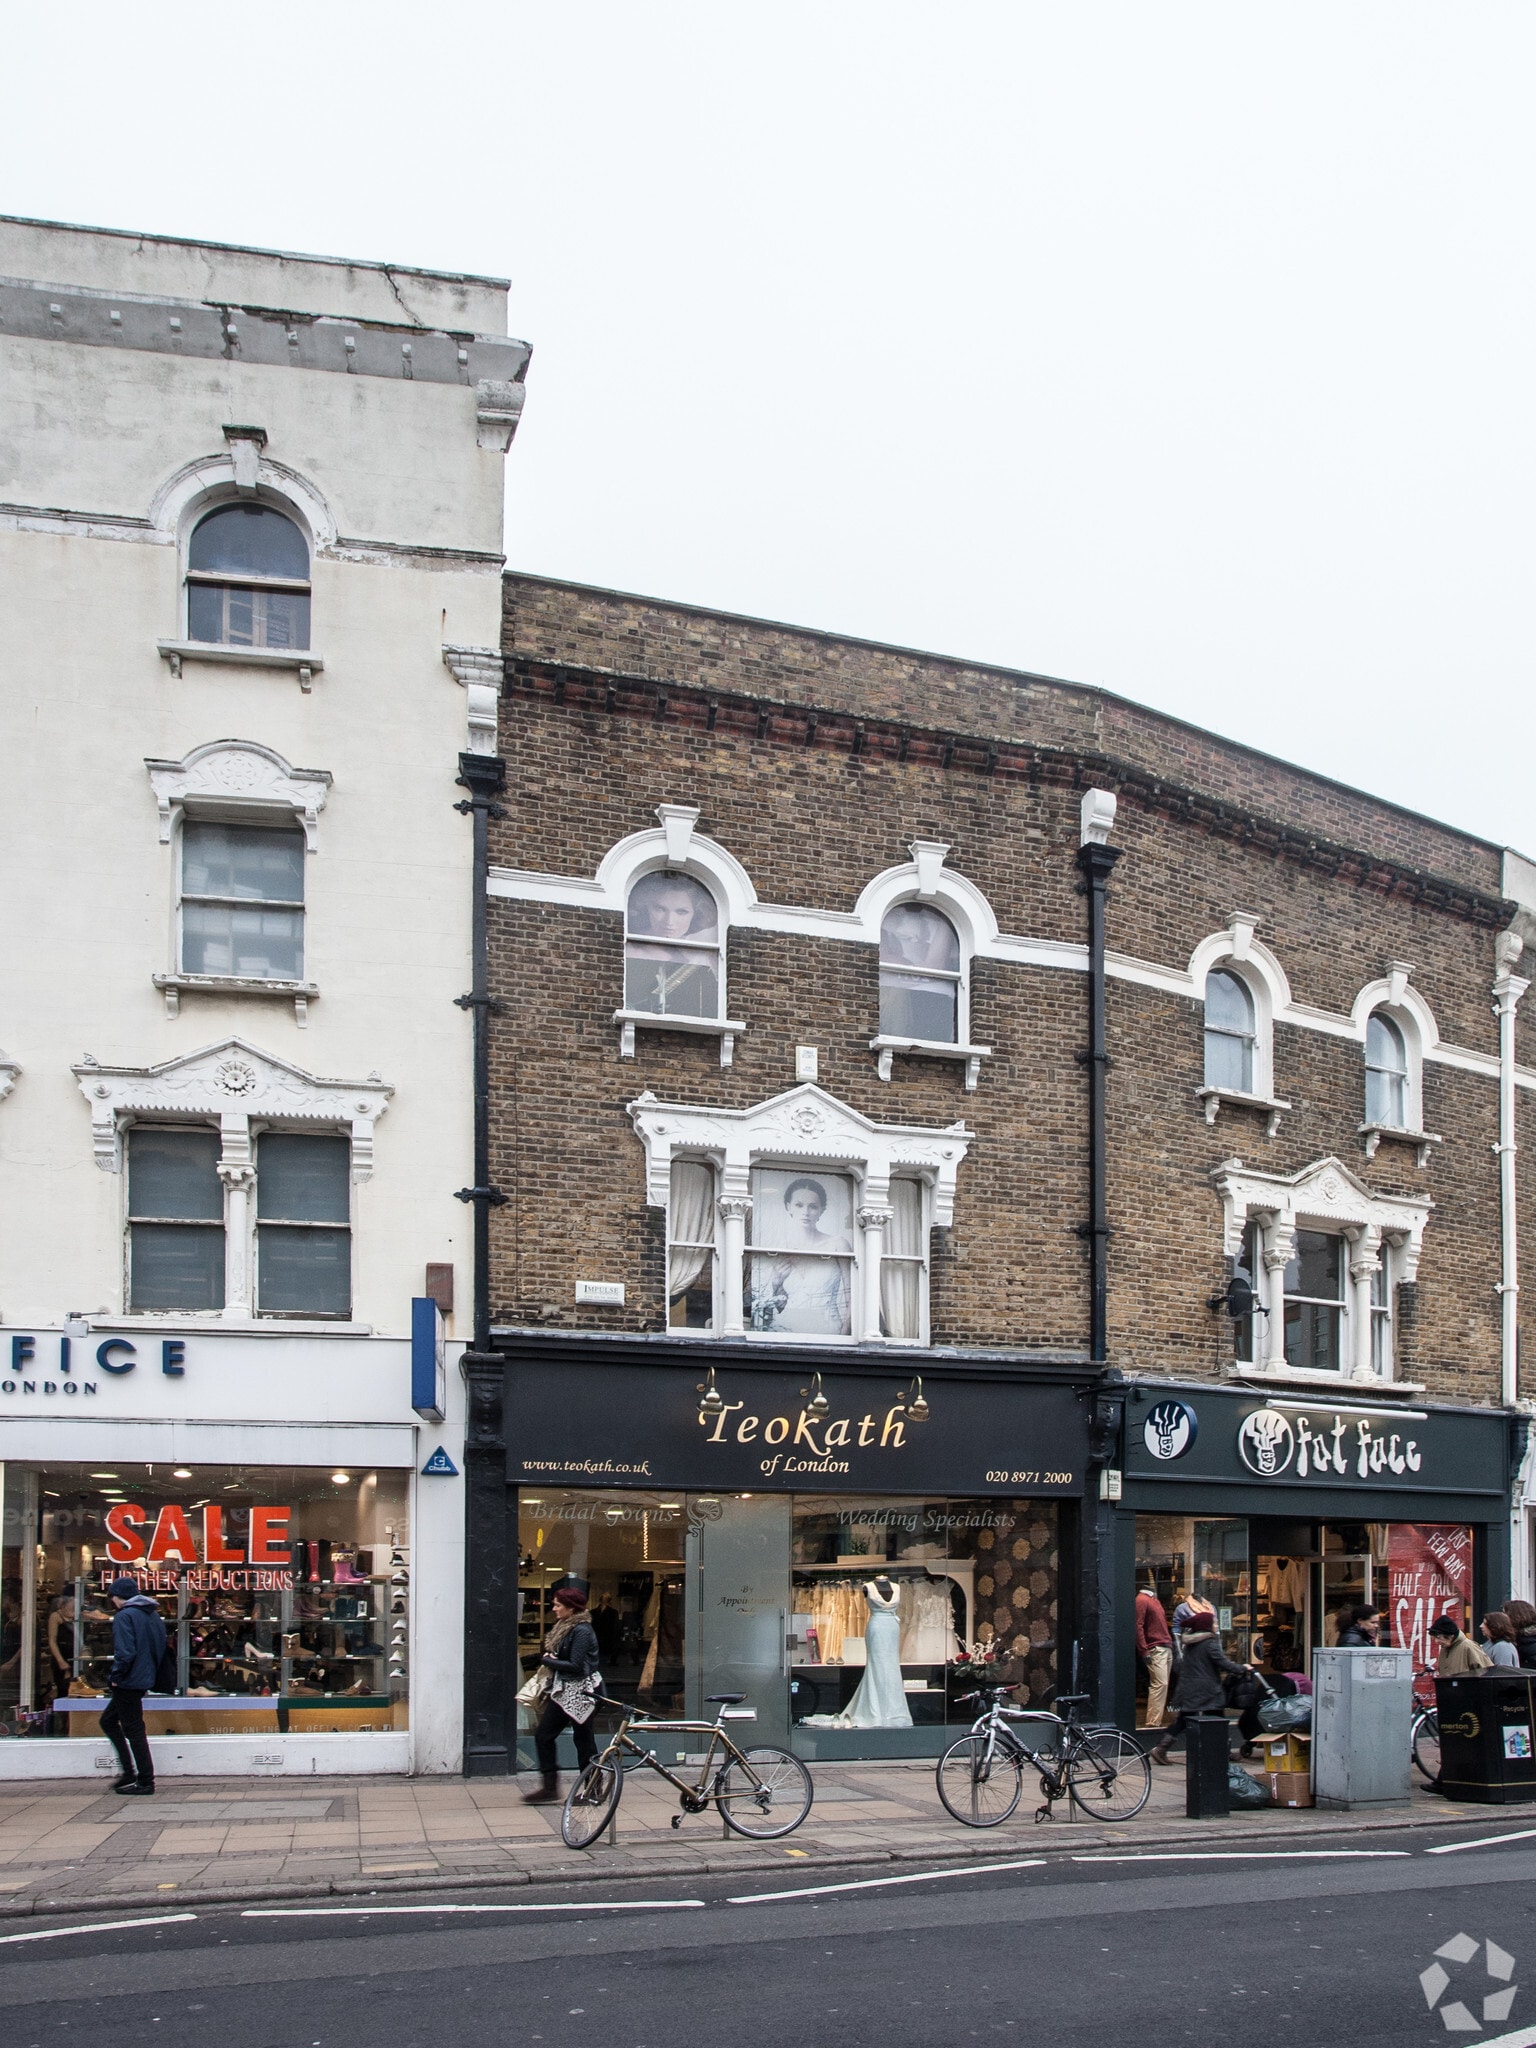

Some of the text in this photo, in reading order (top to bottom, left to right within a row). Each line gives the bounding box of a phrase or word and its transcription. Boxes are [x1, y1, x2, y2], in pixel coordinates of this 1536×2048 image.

[698, 1401, 906, 1456] Teokath
[1296, 1415, 1421, 1478] fat face
[522, 1459, 652, 1476] www.teokath.co.uk
[760, 1454, 849, 1476] of London
[986, 1471, 1072, 1484] 020 8971 2000
[529, 1500, 673, 1526] Bridal Gowns
[836, 1509, 1016, 1531] Wedding Specialists
[105, 1504, 292, 1564] SALE
[1447, 1527, 1471, 1551] LAST
[1426, 1532, 1466, 1580] FEW DAYS
[187, 1569, 295, 1591] REDUCTIONS
[1392, 1573, 1422, 1597] HALF
[1396, 1598, 1460, 1667] SAL
[210, 1727, 235, 1735] SHOP
